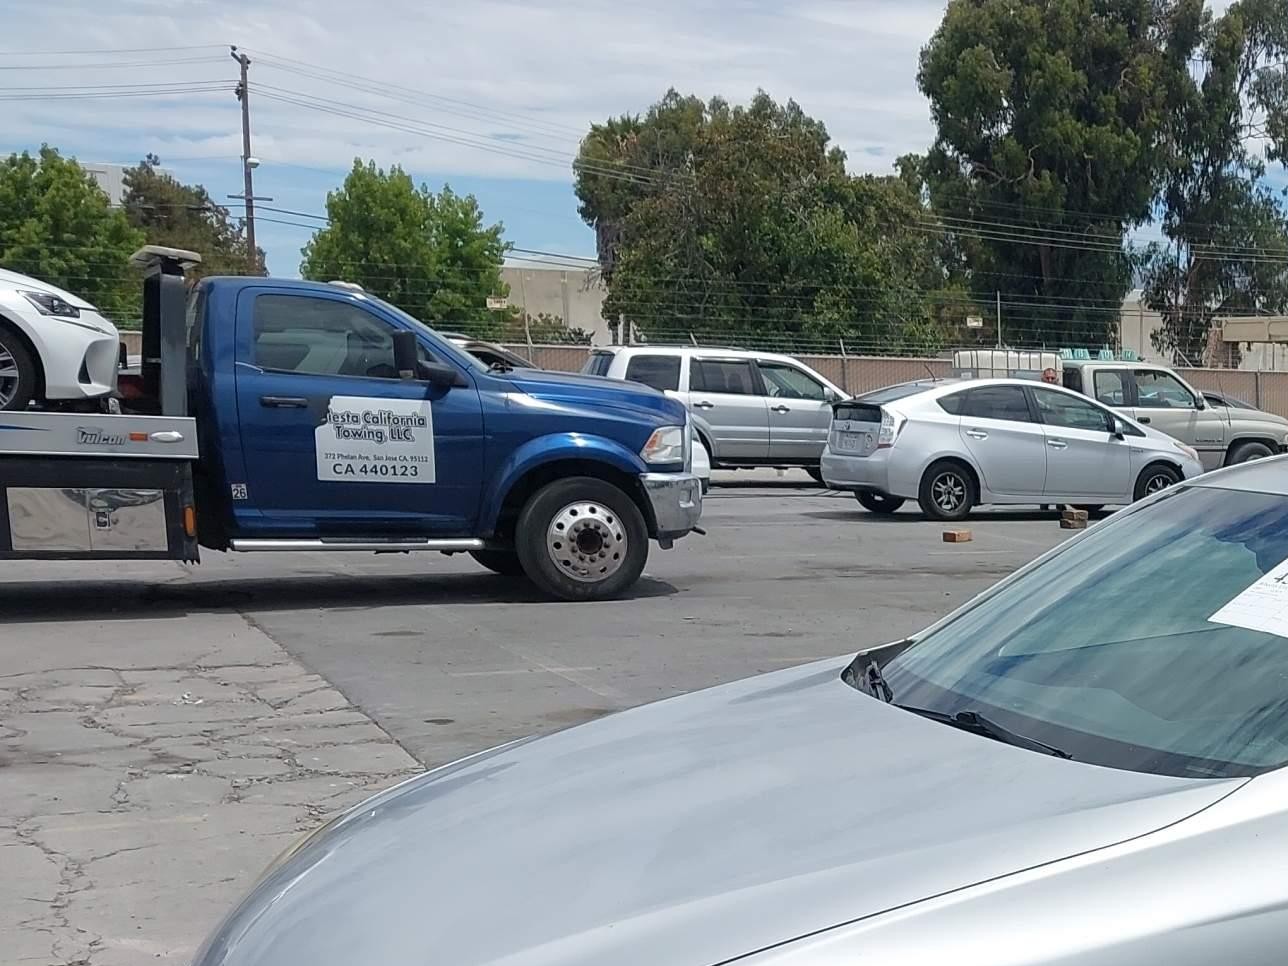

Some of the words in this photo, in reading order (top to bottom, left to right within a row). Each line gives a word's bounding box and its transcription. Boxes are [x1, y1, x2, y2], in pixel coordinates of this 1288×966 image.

[327, 409, 361, 425] iesta
[362, 409, 428, 428] California
[332, 463, 356, 475] CA
[359, 463, 418, 477] 440123
